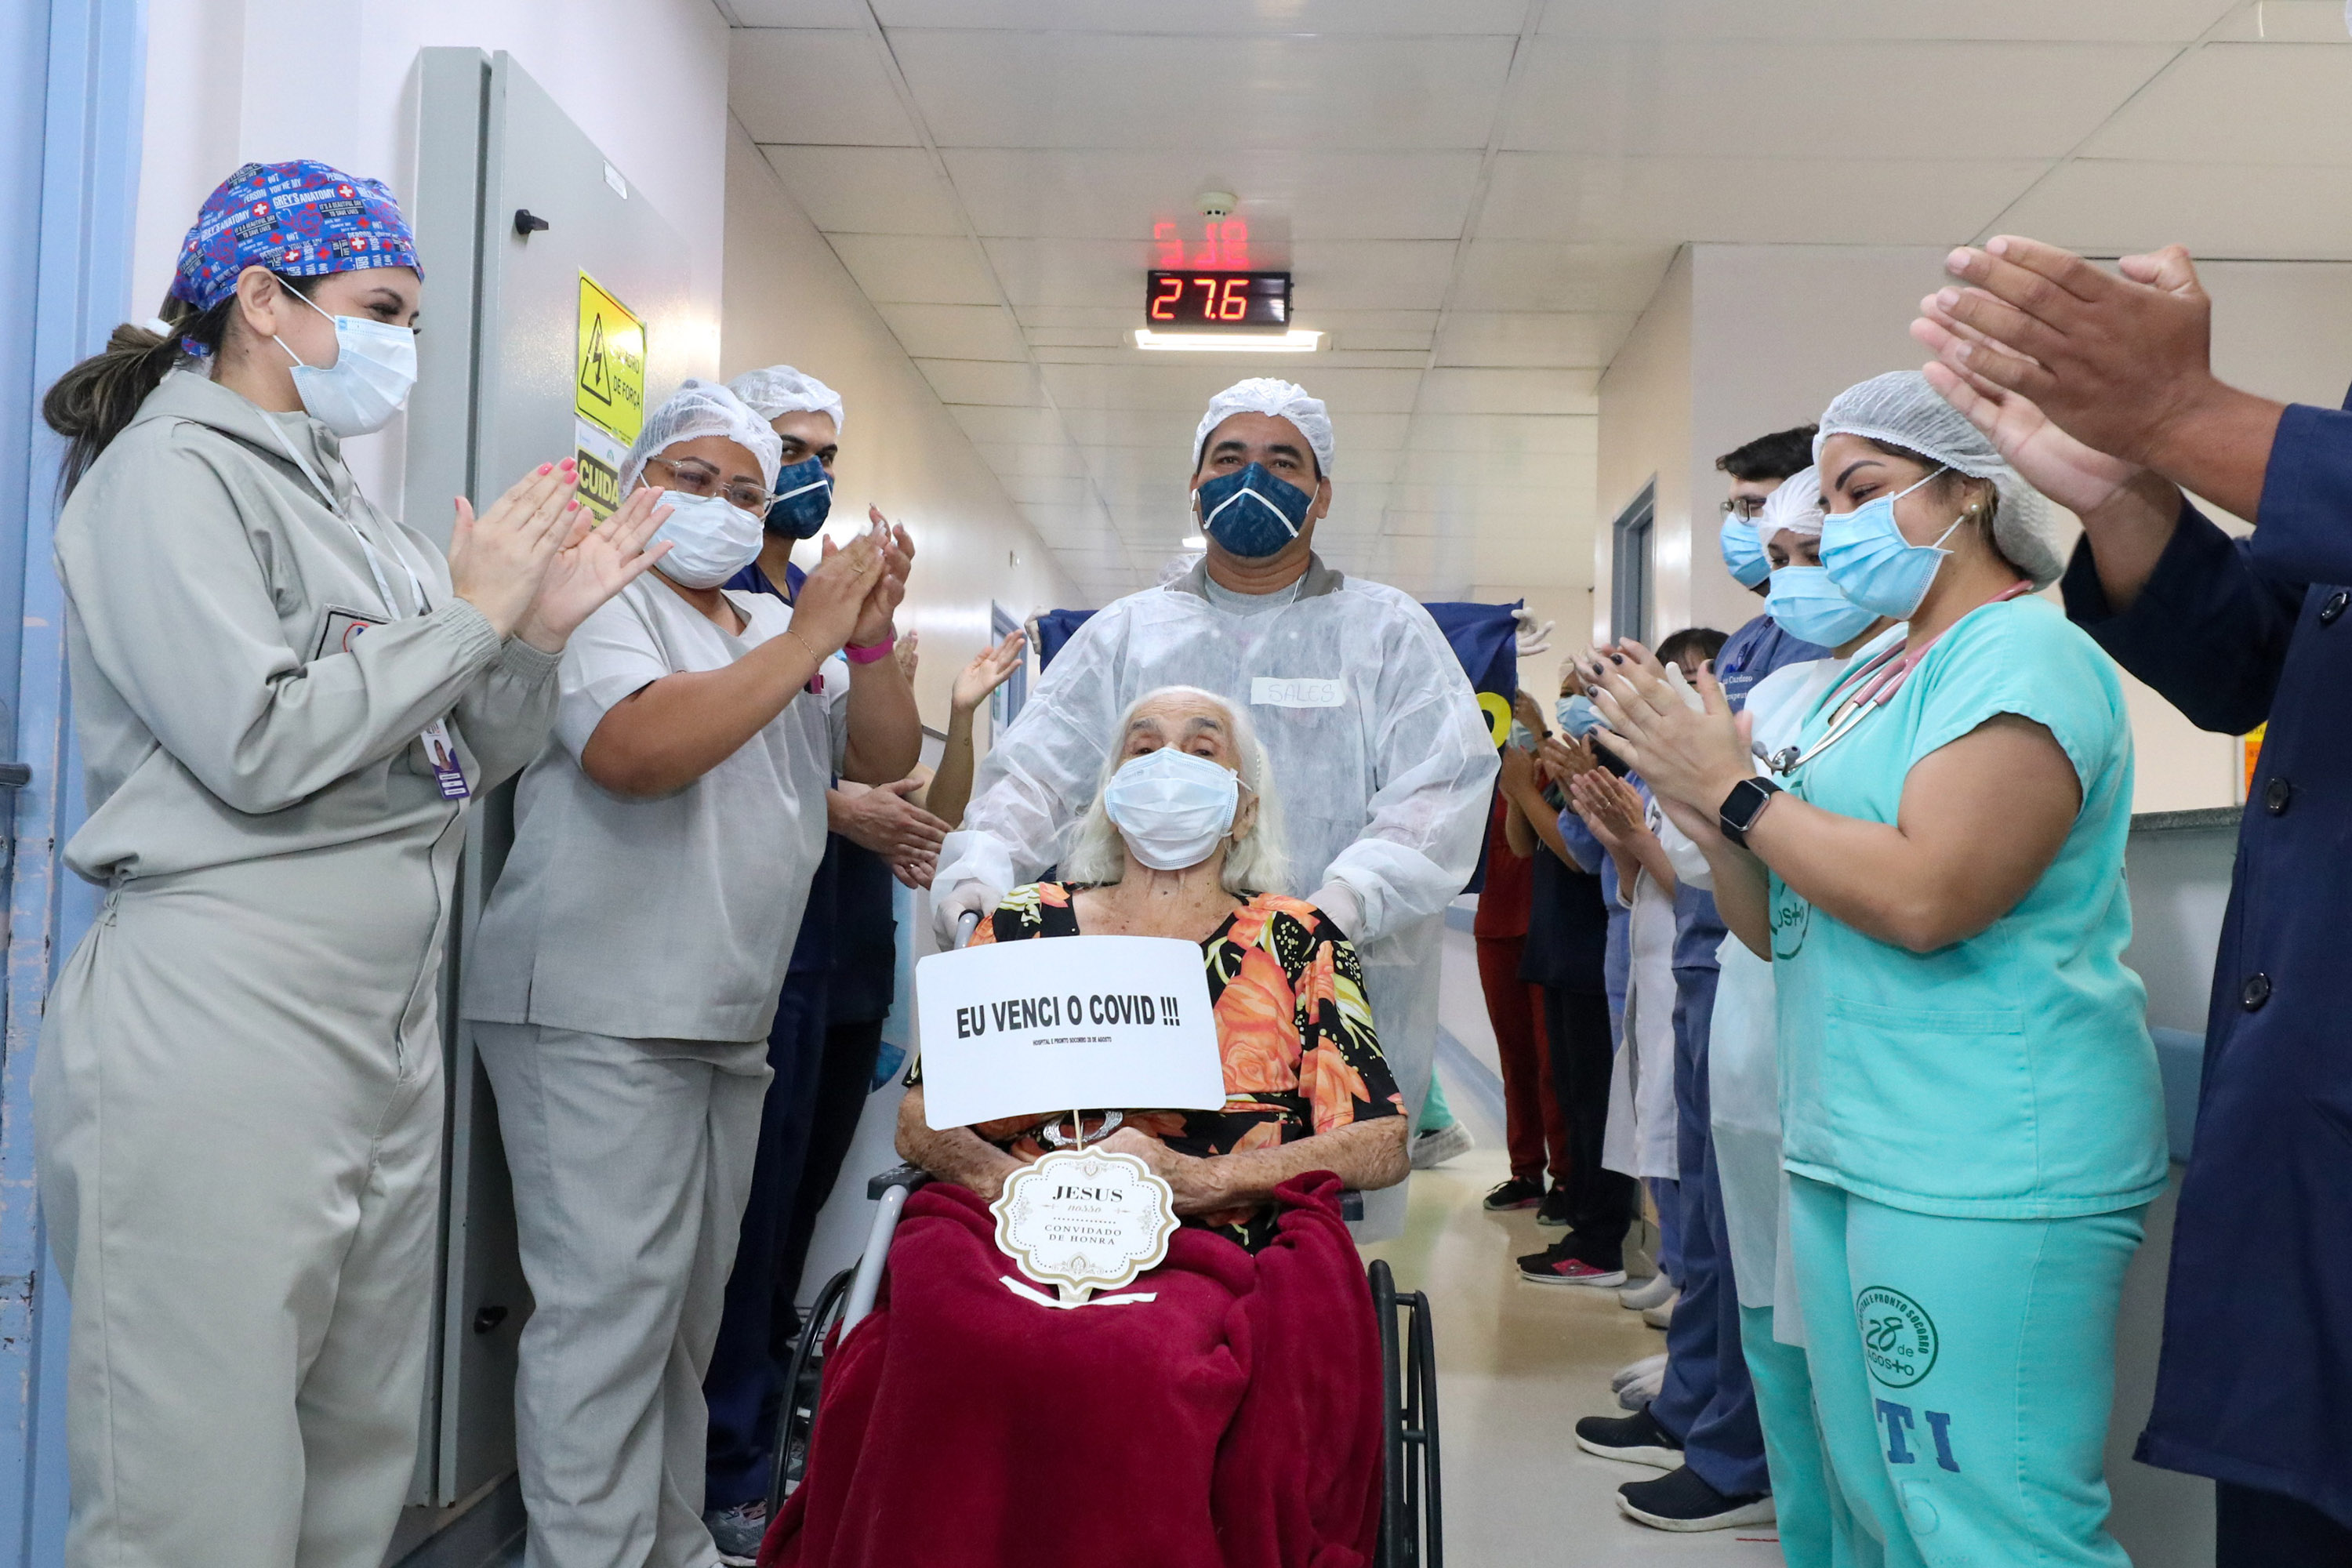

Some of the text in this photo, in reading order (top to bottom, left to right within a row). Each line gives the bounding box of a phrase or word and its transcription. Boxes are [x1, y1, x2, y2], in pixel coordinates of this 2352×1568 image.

[269, 178, 301, 194] YOU'RE MY
[244, 188, 267, 204] PERSON
[272, 188, 336, 207] GREY'S ANATOMY
[220, 209, 250, 231] ANATOMY
[1152, 278, 1250, 320] 27.6
[613, 376, 641, 410] DE FORÇA
[1268, 683, 1335, 702] SALES
[956, 994, 1181, 1039] EU VENCI O COVID !!!
[1052, 1185, 1123, 1203] JESUS
[1067, 1204, 1102, 1214] nosso
[1044, 1224, 1122, 1237] CONVIDADO
[1049, 1233, 1115, 1246] DE HONRA
[1875, 1294, 1907, 1312] PRONTO
[1906, 1310, 1929, 1354] SOCORRO
[1866, 1316, 1914, 1357] 28 de
